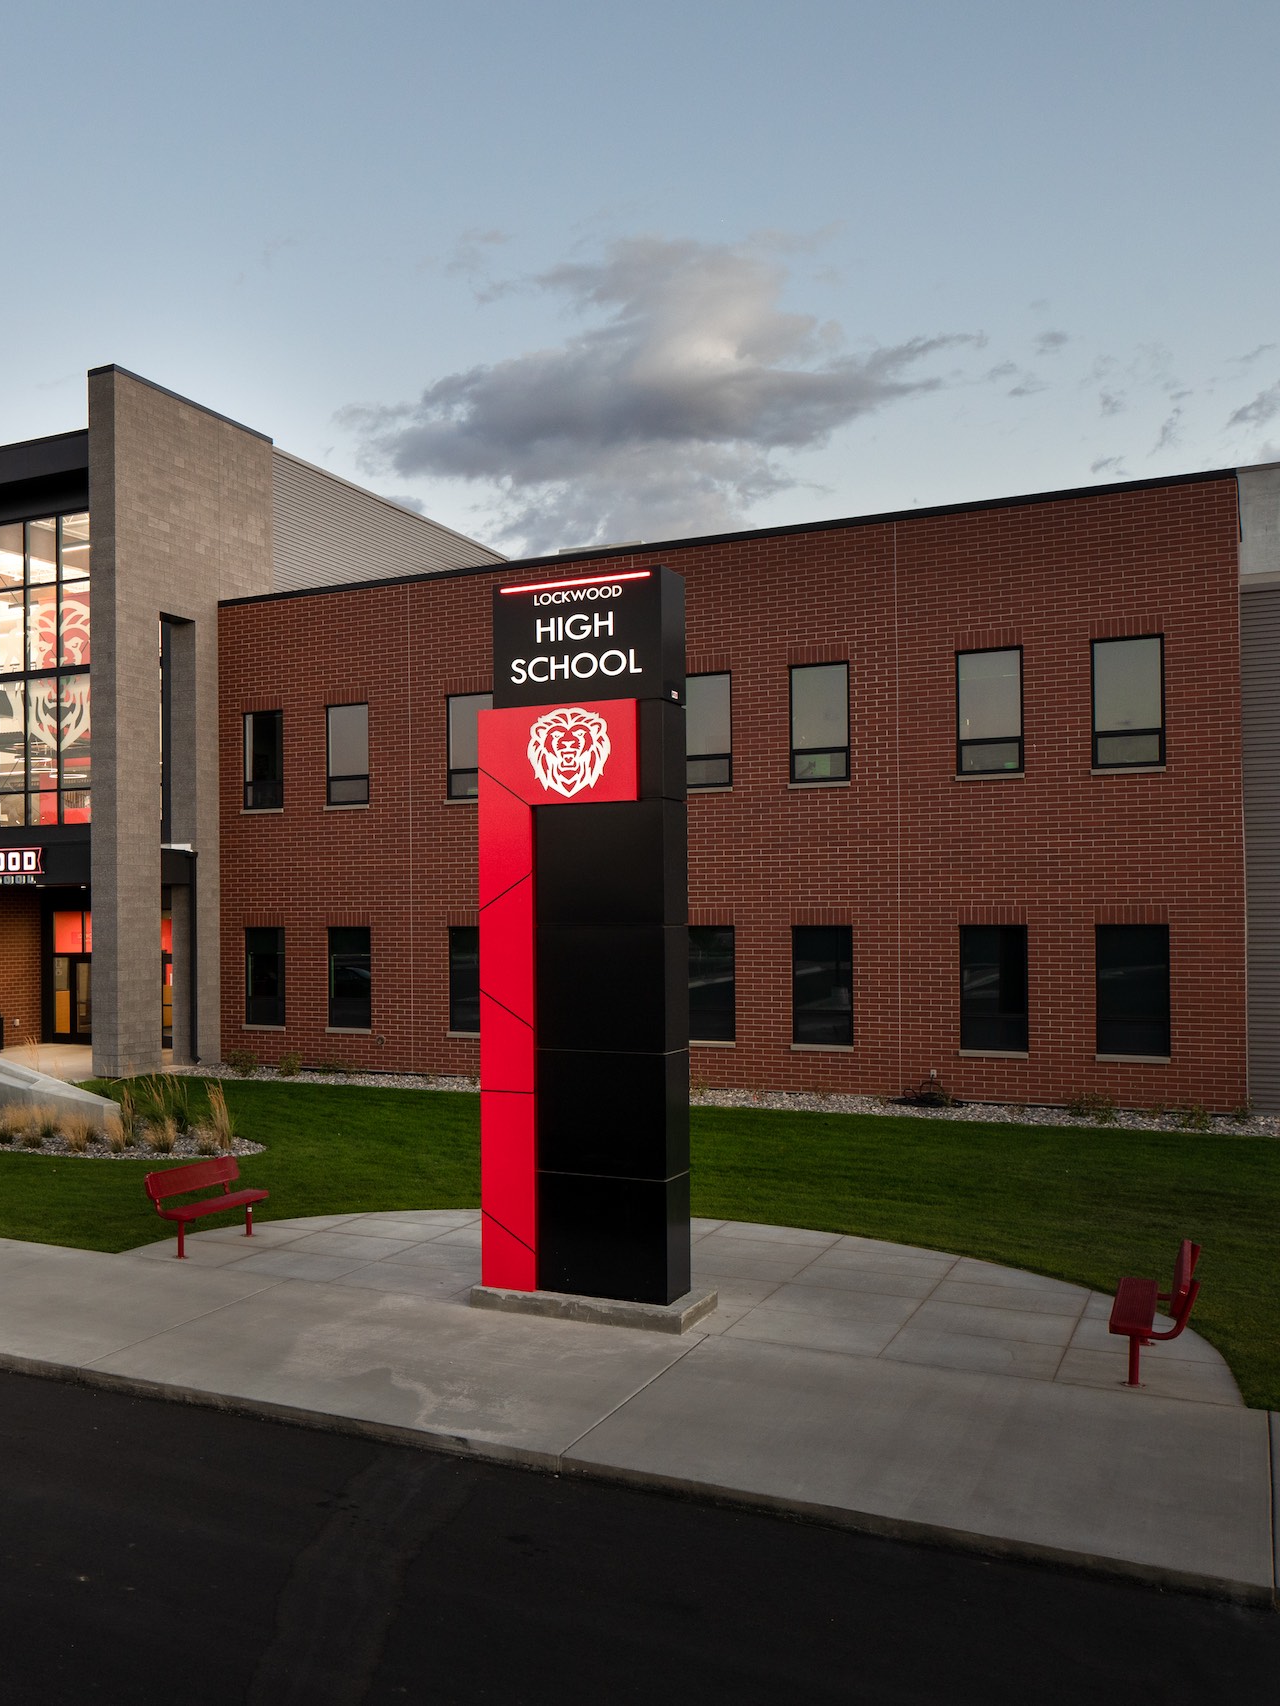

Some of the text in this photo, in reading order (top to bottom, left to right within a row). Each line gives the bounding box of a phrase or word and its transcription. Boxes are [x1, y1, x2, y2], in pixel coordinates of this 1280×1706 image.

[533, 585, 623, 607] LOCKWOOD
[535, 610, 614, 643] HIGH
[510, 648, 643, 685] SCHOOL
